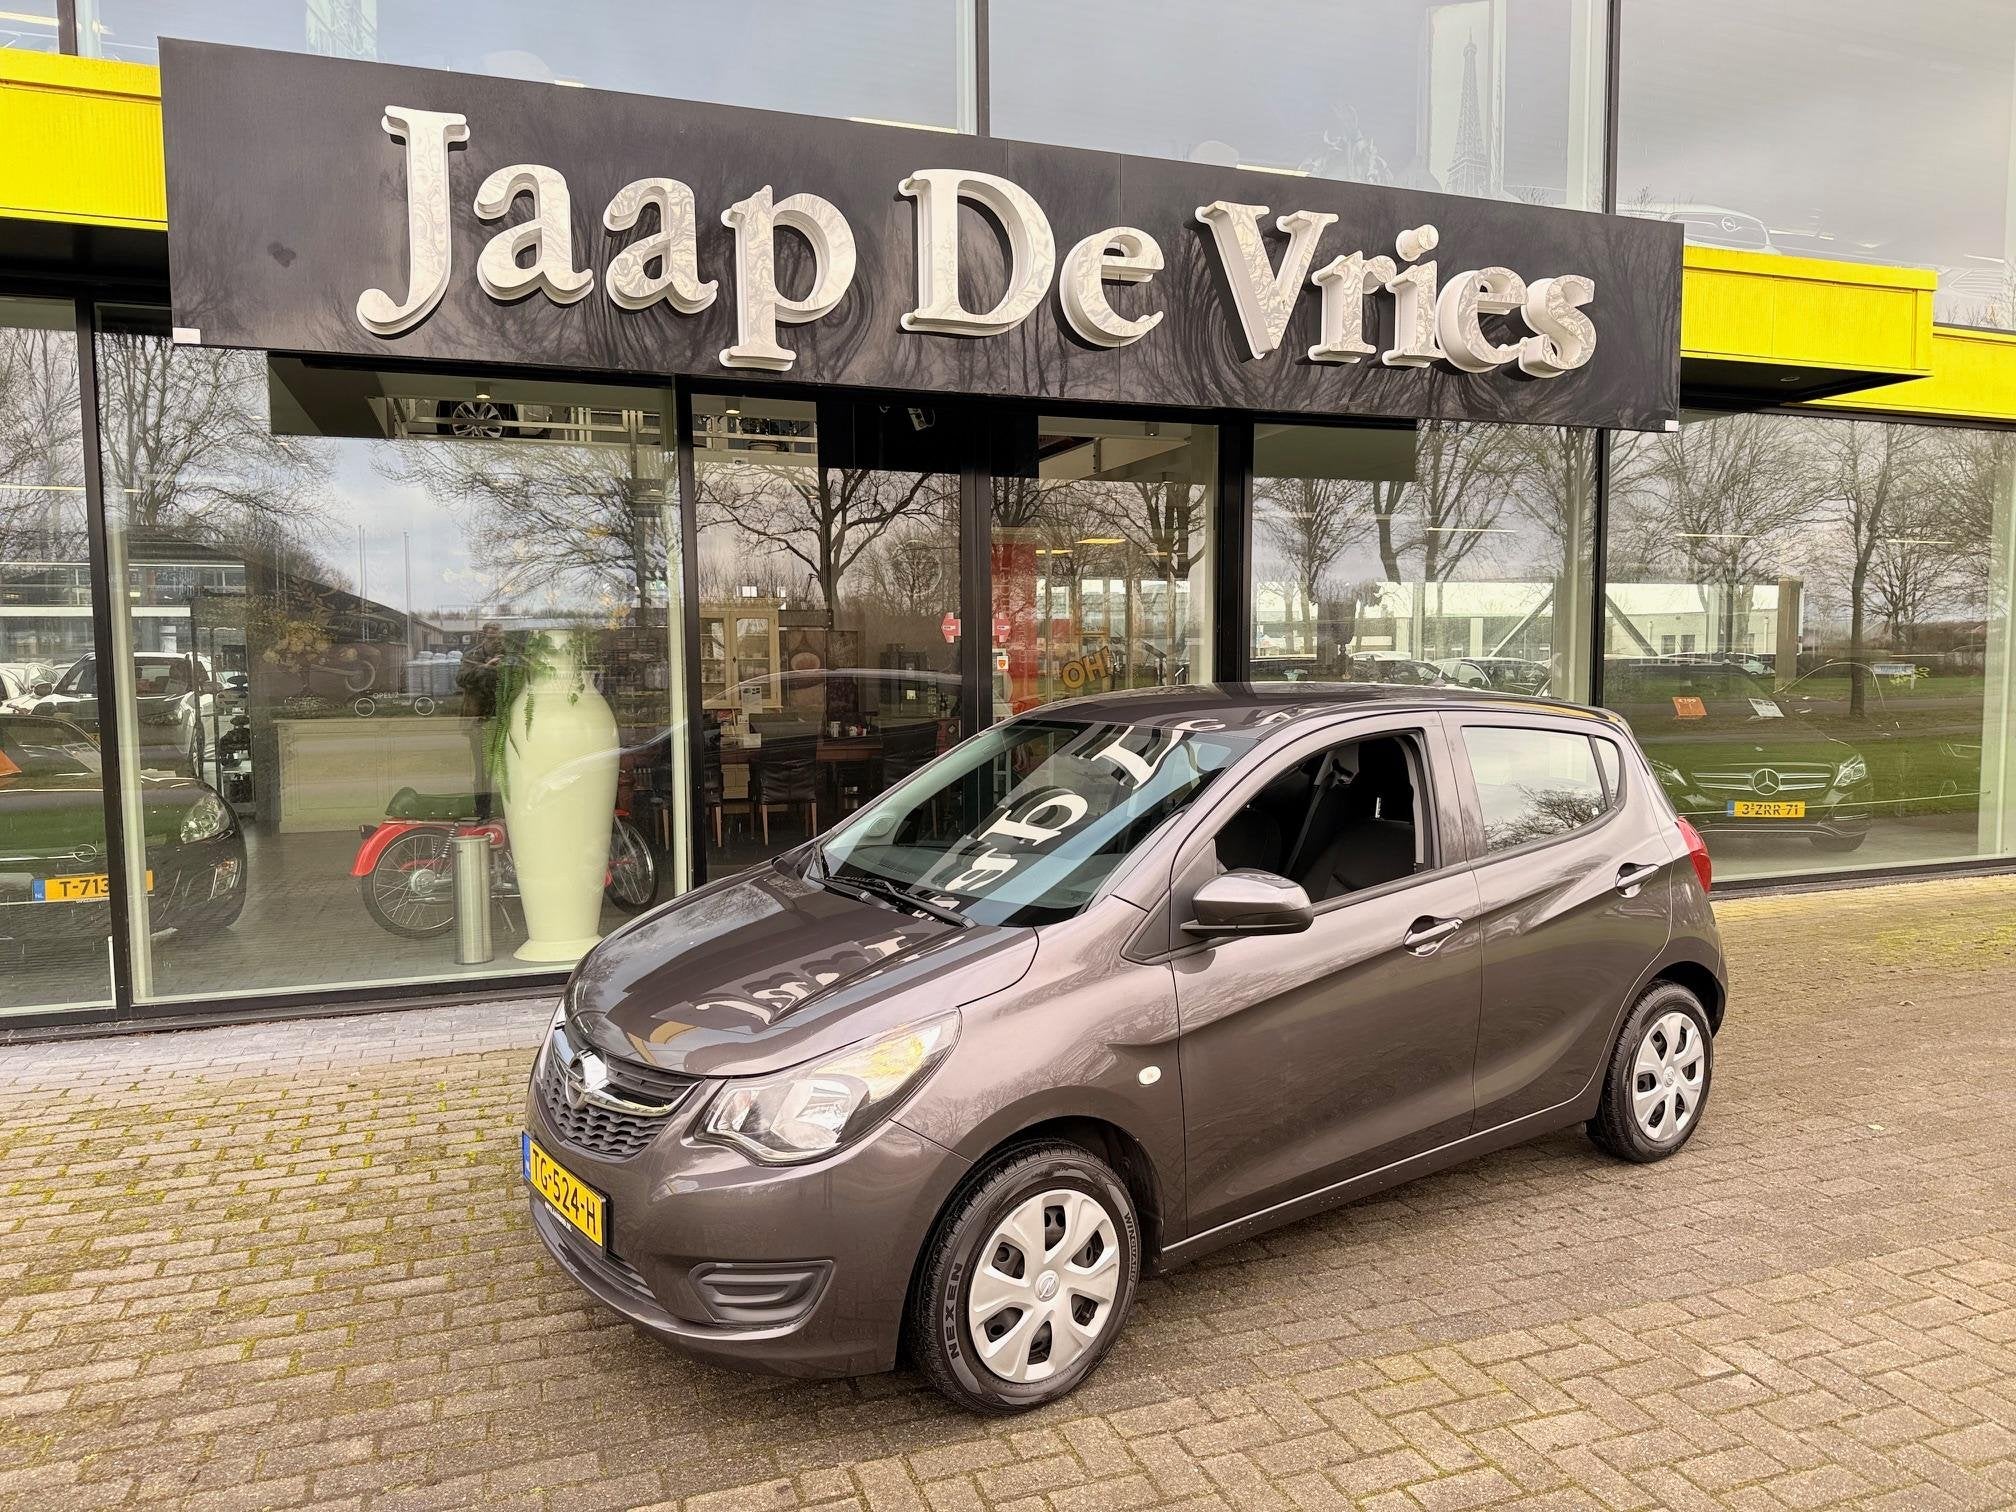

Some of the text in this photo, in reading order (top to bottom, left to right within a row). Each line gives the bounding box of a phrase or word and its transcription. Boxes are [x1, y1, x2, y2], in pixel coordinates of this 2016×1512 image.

[356, 104, 1597, 379] Jaap De Vries
[59, 877, 109, 897] T-713
[532, 1148, 597, 1236] TG-524-H
[944, 1262, 963, 1360] NEXEN
